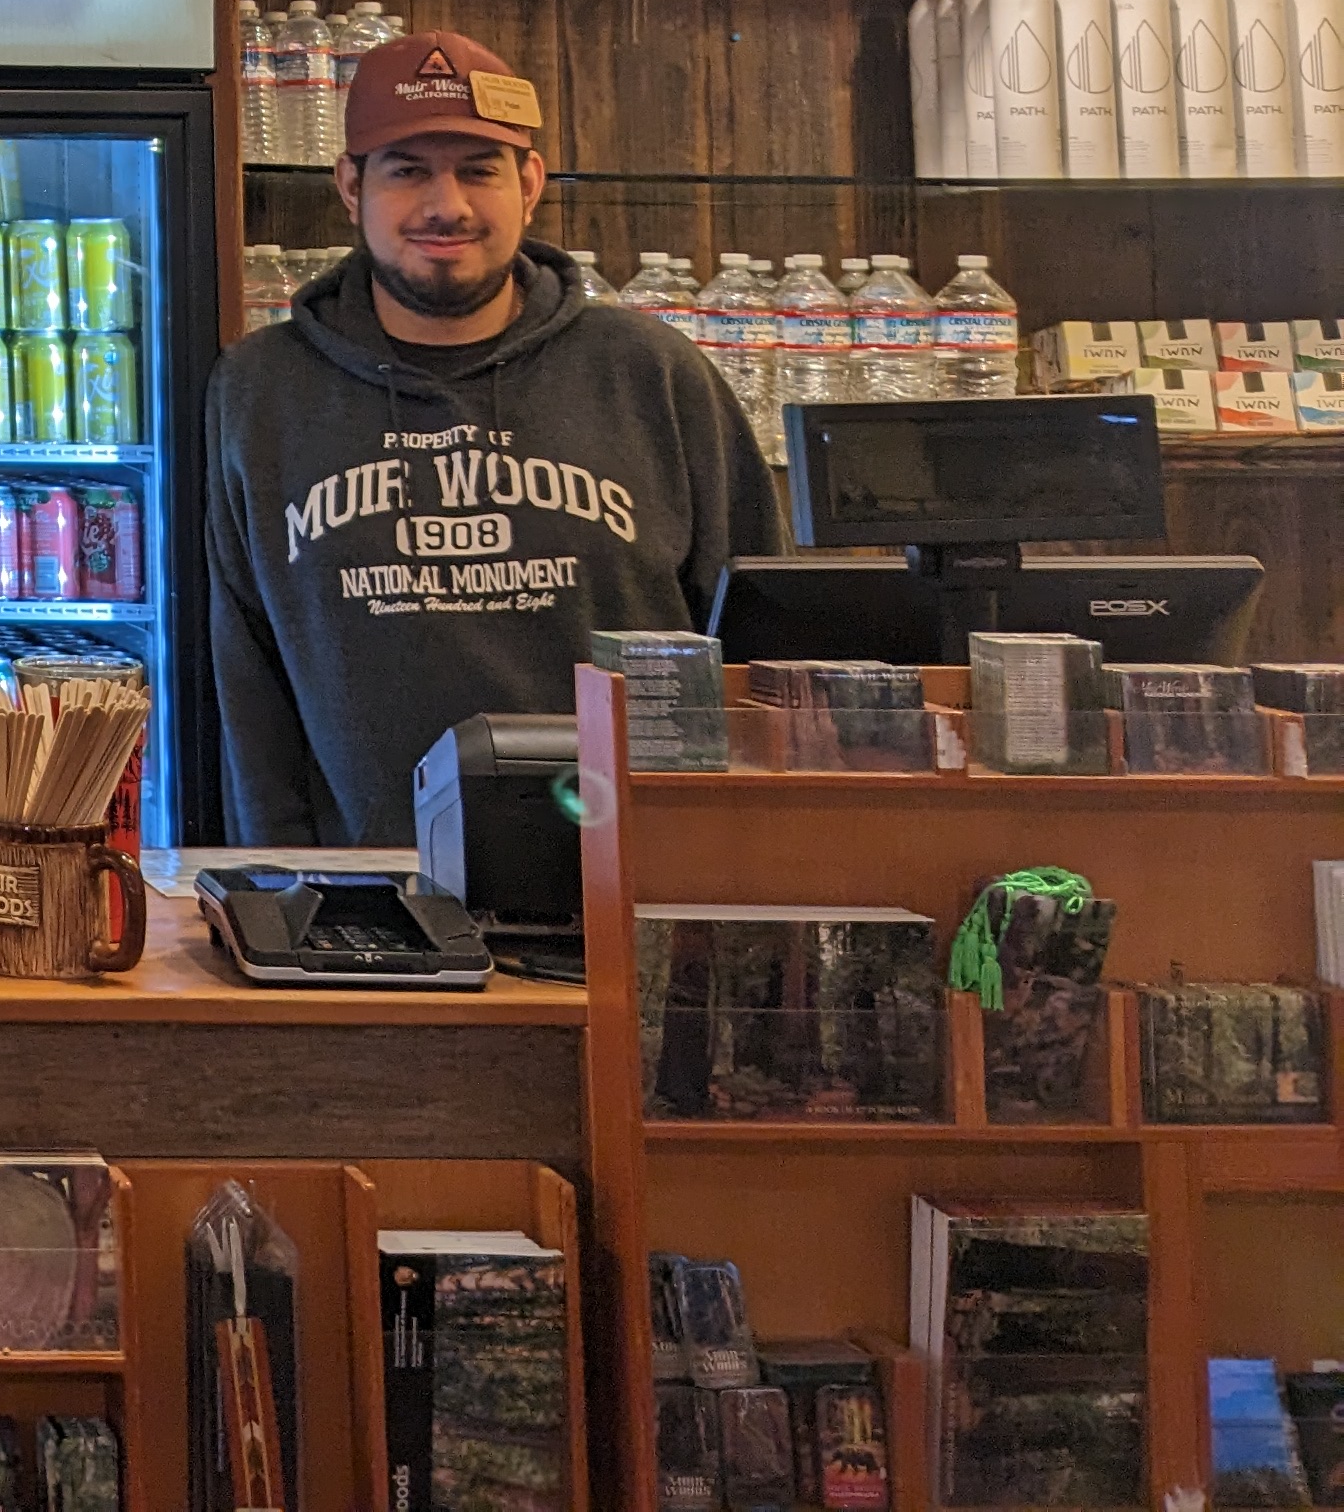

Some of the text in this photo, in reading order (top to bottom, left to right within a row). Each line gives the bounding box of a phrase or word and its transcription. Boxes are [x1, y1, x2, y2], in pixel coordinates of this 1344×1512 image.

[405, 92, 469, 101] CALIFORNIA
[720, 317, 754, 325] CRYSTAL
[799, 319, 832, 327] CRYSTAL
[948, 317, 981, 326] CRYSTAL
[383, 424, 479, 449] PROPERTY
[284, 449, 638, 565] MUIR WOODS
[410, 517, 501, 551] 1908
[339, 555, 579, 599] NATIONAL MONUMENT
[367, 592, 556, 615] Nineteen Hundred and Eight
